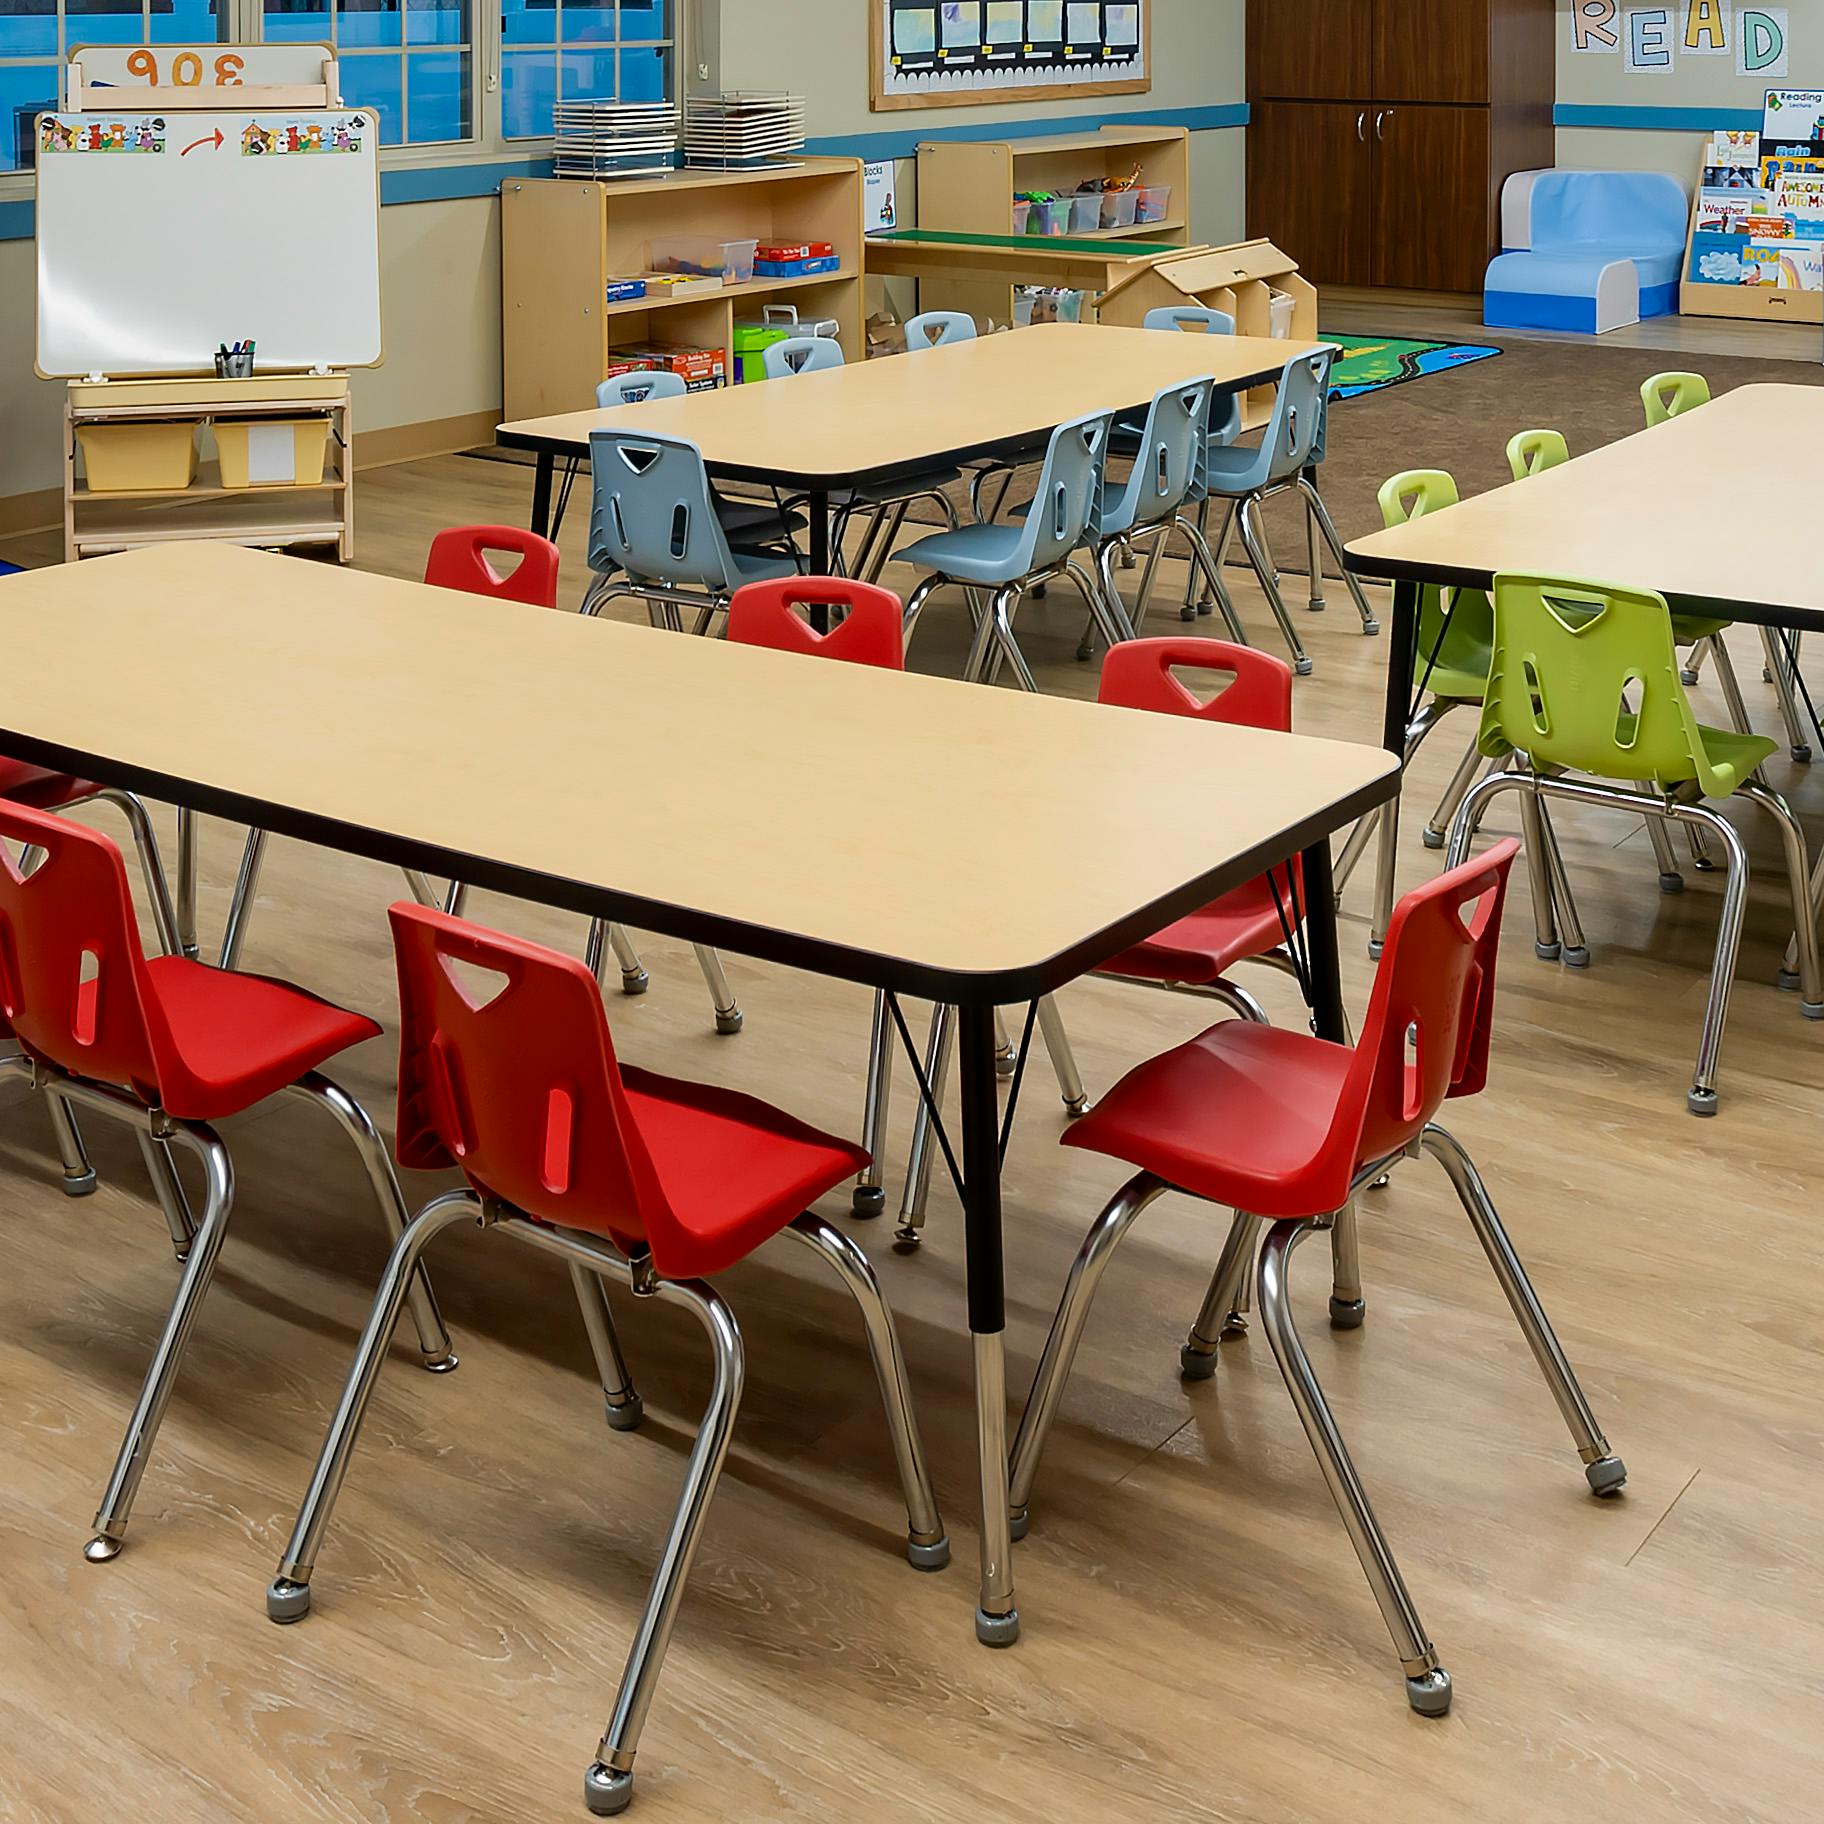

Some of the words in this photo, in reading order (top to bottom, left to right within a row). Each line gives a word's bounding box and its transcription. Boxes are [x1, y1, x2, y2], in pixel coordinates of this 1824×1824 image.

[1780, 92, 1822, 103] Reading
[1776, 145, 1811, 157] Rain
[1781, 180, 1824, 193] AWESOME
[1703, 204, 1745, 215] Weather
